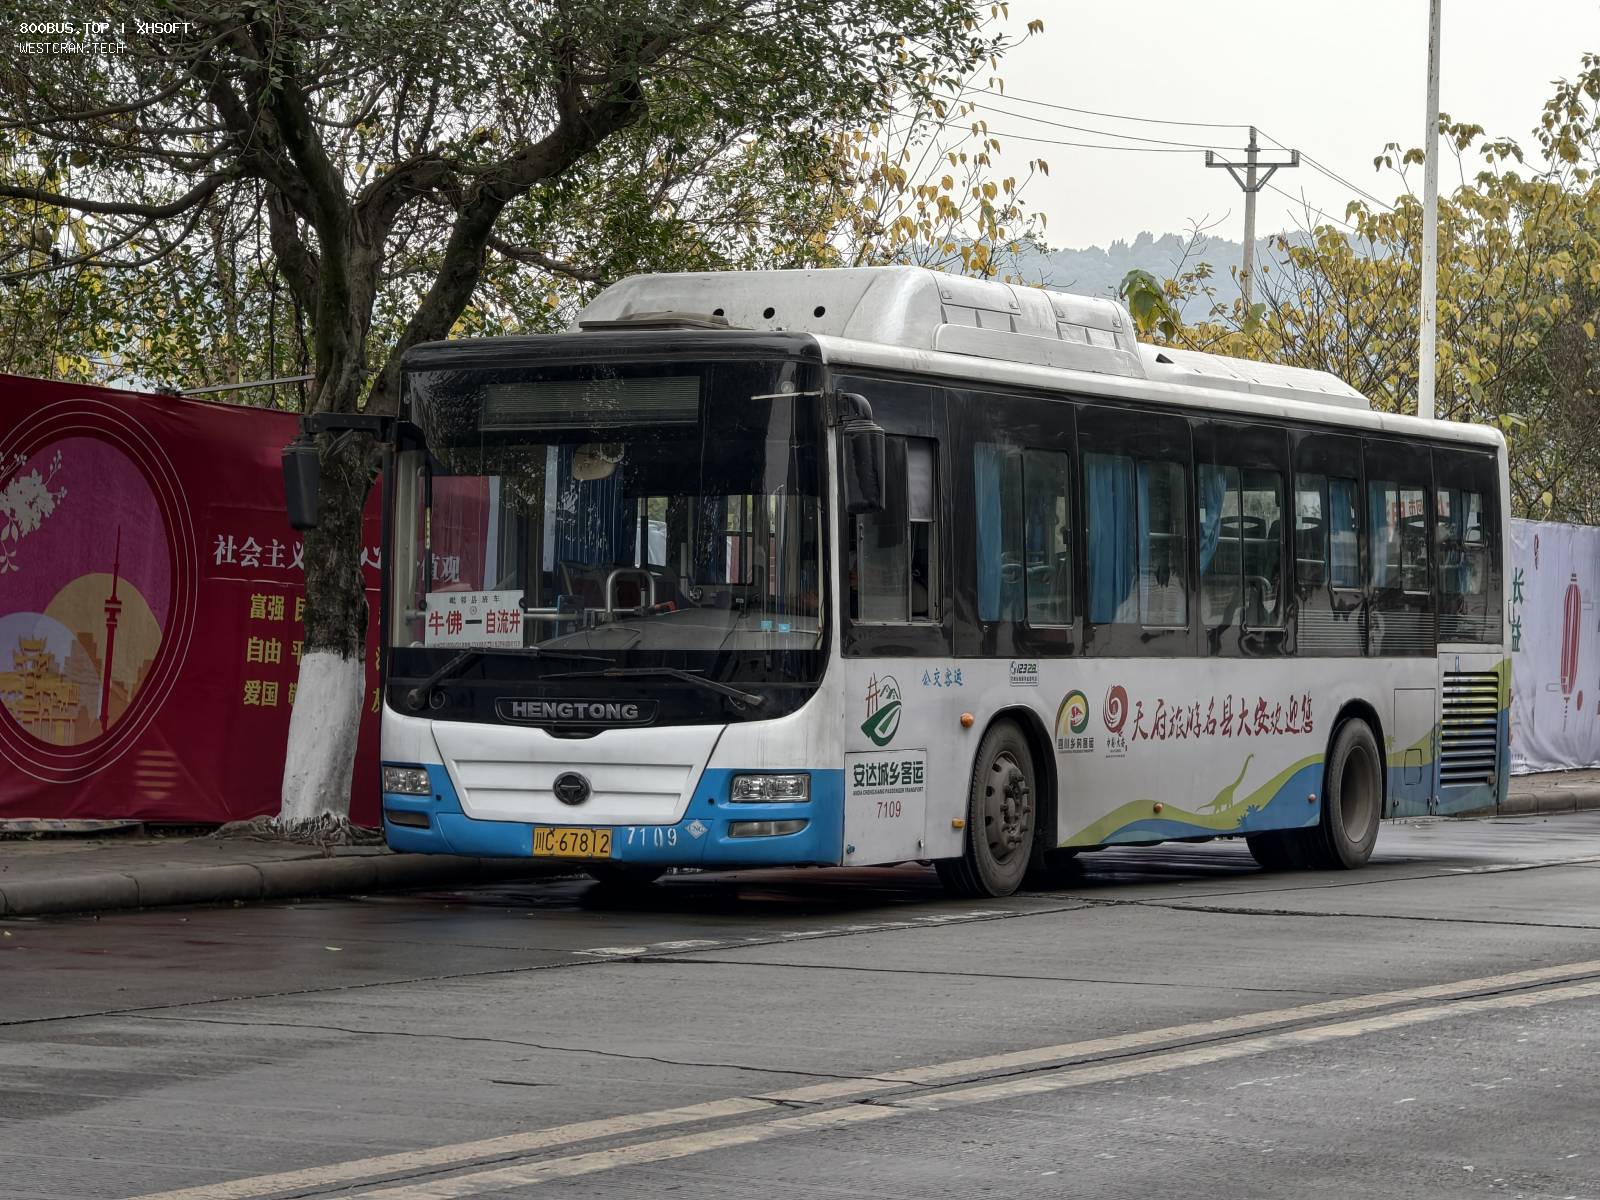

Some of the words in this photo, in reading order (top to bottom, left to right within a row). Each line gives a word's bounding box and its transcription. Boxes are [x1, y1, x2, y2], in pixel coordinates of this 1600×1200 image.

[250, 593, 285, 621] 富强
[246, 636, 282, 664] 自由
[243, 679, 279, 707] 爱国
[512, 701, 639, 719] HENGTONG
[1131, 691, 1314, 742] 天府旅游名县大安欢迎您
[853, 761, 924, 788] 安达城乡客运
[877, 800, 902, 819] 7109
[627, 827, 677, 847] 7109
